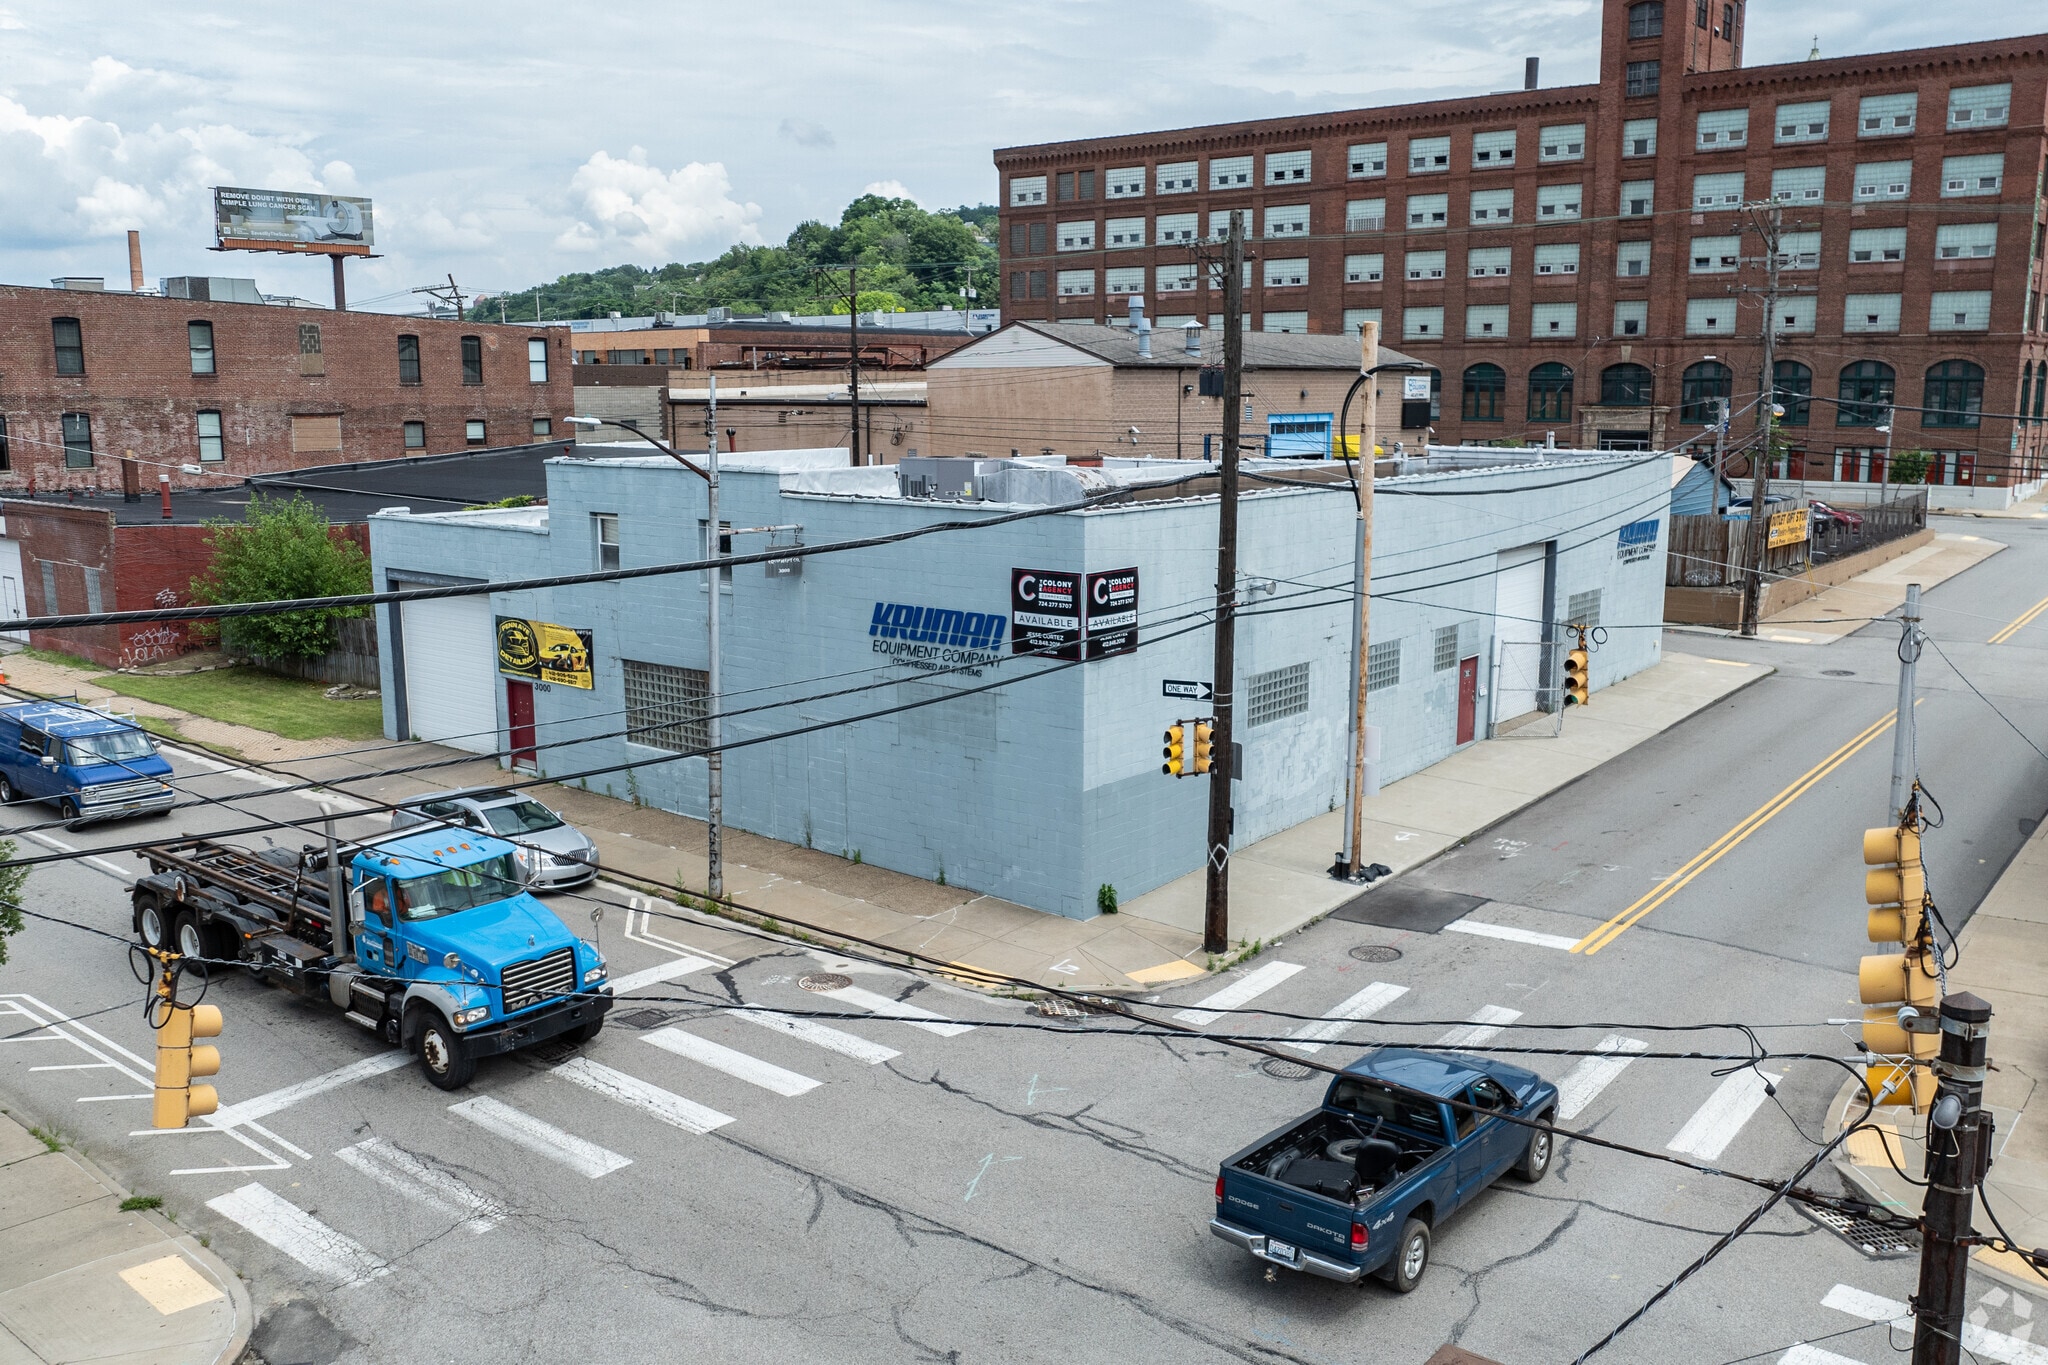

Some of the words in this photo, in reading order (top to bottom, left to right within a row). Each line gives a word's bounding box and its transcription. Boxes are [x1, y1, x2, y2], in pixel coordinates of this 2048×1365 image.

[221, 192, 249, 200] REMOVE
[222, 199, 247, 207] SIMPLE
[269, 202, 296, 210] CANCER
[1043, 580, 1072, 588] COLONY
[1112, 577, 1134, 585] COLONY
[1112, 583, 1134, 591] AGENCY
[1019, 575, 1036, 601] C
[1094, 578, 1108, 604] C
[869, 602, 1007, 651] KRUMAN
[1019, 616, 1072, 627] AVAILABLE
[1093, 614, 1133, 628] AVAILABLE
[502, 622, 518, 631] PENN
[518, 624, 530, 635] AVE
[500, 650, 534, 665] DETAILING
[873, 640, 940, 659] EQUIPMENT
[942, 648, 1004, 668] COMPANY
[893, 658, 937, 671] COMPRESSED
[535, 684, 551, 692] 3000
[1228, 1196, 1259, 1210] DODGE
[1373, 1212, 1394, 1230] 4x4
[1307, 1222, 1345, 1240] DAKOTA
